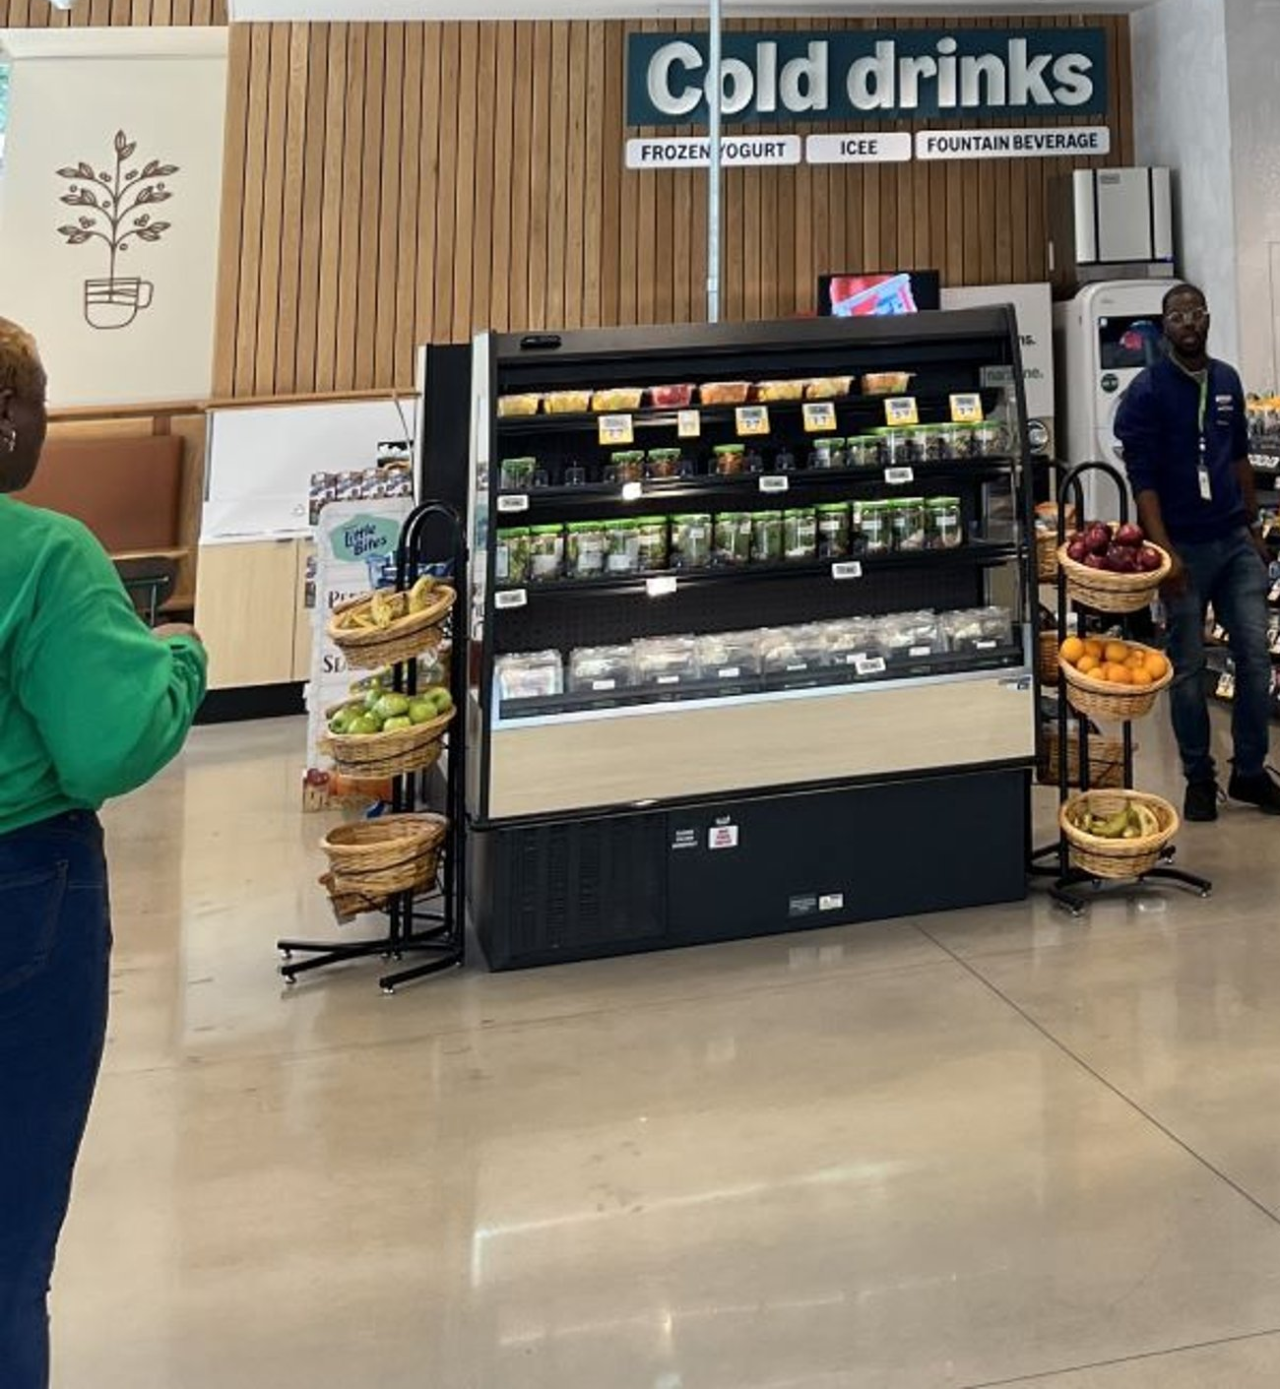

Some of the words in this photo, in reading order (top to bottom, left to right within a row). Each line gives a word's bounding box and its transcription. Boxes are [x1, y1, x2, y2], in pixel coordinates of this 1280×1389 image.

[646, 40, 829, 115] Cold
[846, 36, 1094, 111] drinks
[641, 143, 711, 161] FROZEN
[840, 139, 878, 156] ICEE
[926, 135, 1012, 153] FOUNTAIN
[1013, 132, 1099, 151] BEVERAGE
